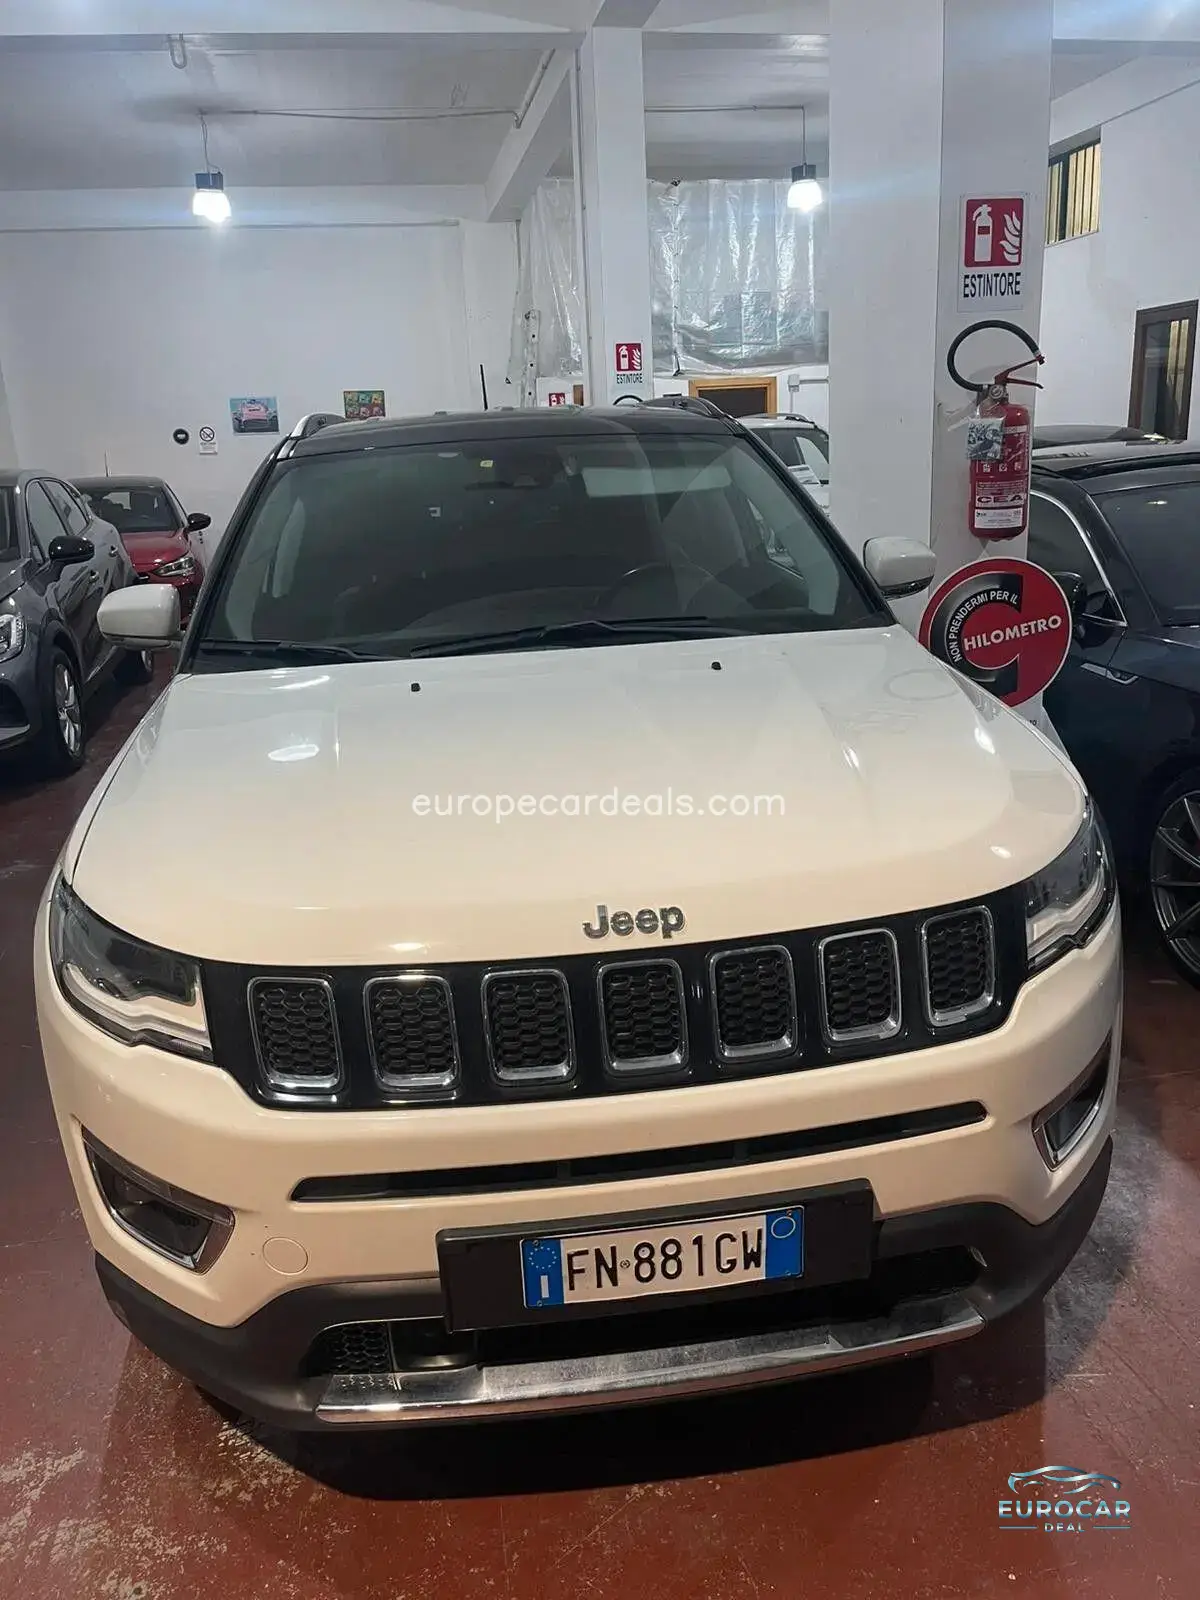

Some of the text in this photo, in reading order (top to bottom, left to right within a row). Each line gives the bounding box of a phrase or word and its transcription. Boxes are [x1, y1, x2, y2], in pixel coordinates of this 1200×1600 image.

[963, 272, 1021, 298] ESTINTORE
[616, 373, 643, 384] ESTINTORE
[948, 590, 1019, 662] NON PRENDERMI PER IL
[582, 904, 686, 939] Jeep
